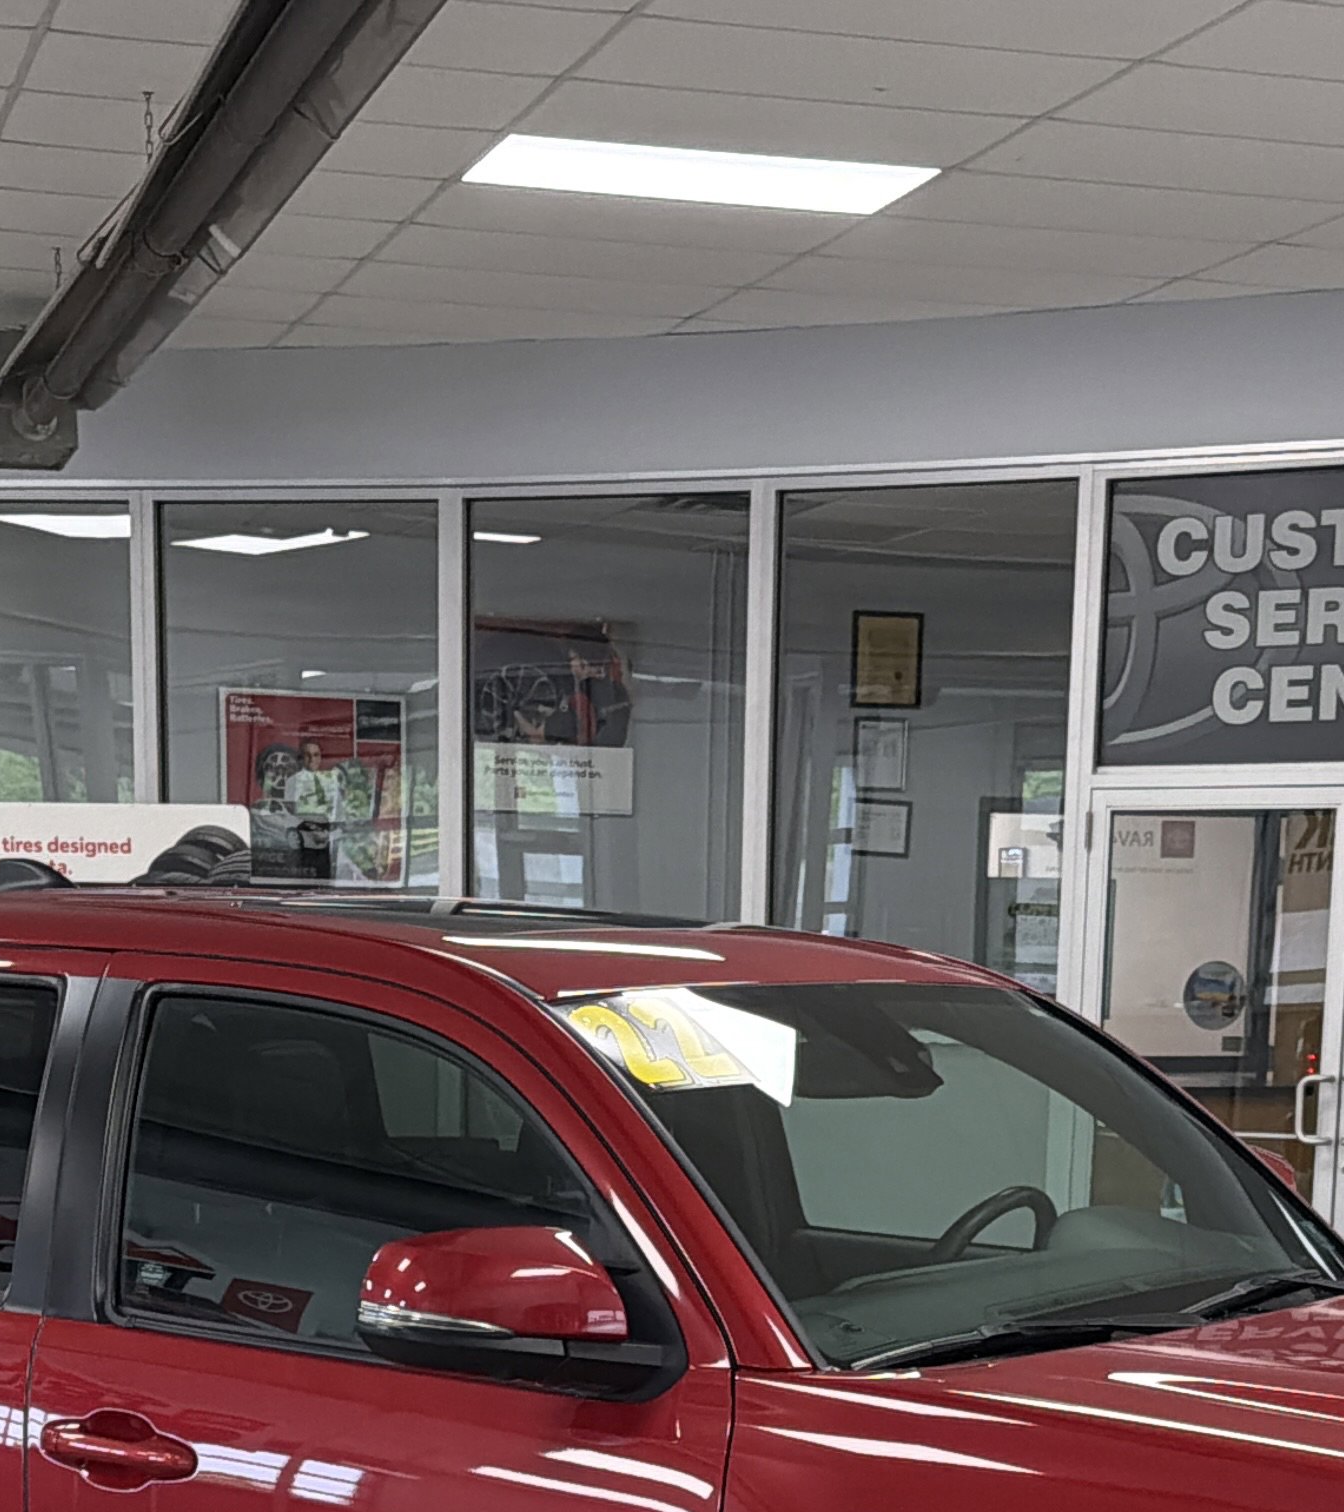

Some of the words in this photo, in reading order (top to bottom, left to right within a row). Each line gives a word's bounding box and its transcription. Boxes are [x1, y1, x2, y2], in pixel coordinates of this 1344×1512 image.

[2, 836, 43, 854] tires
[47, 838, 132, 858] designed
[567, 1000, 743, 1086] 22
